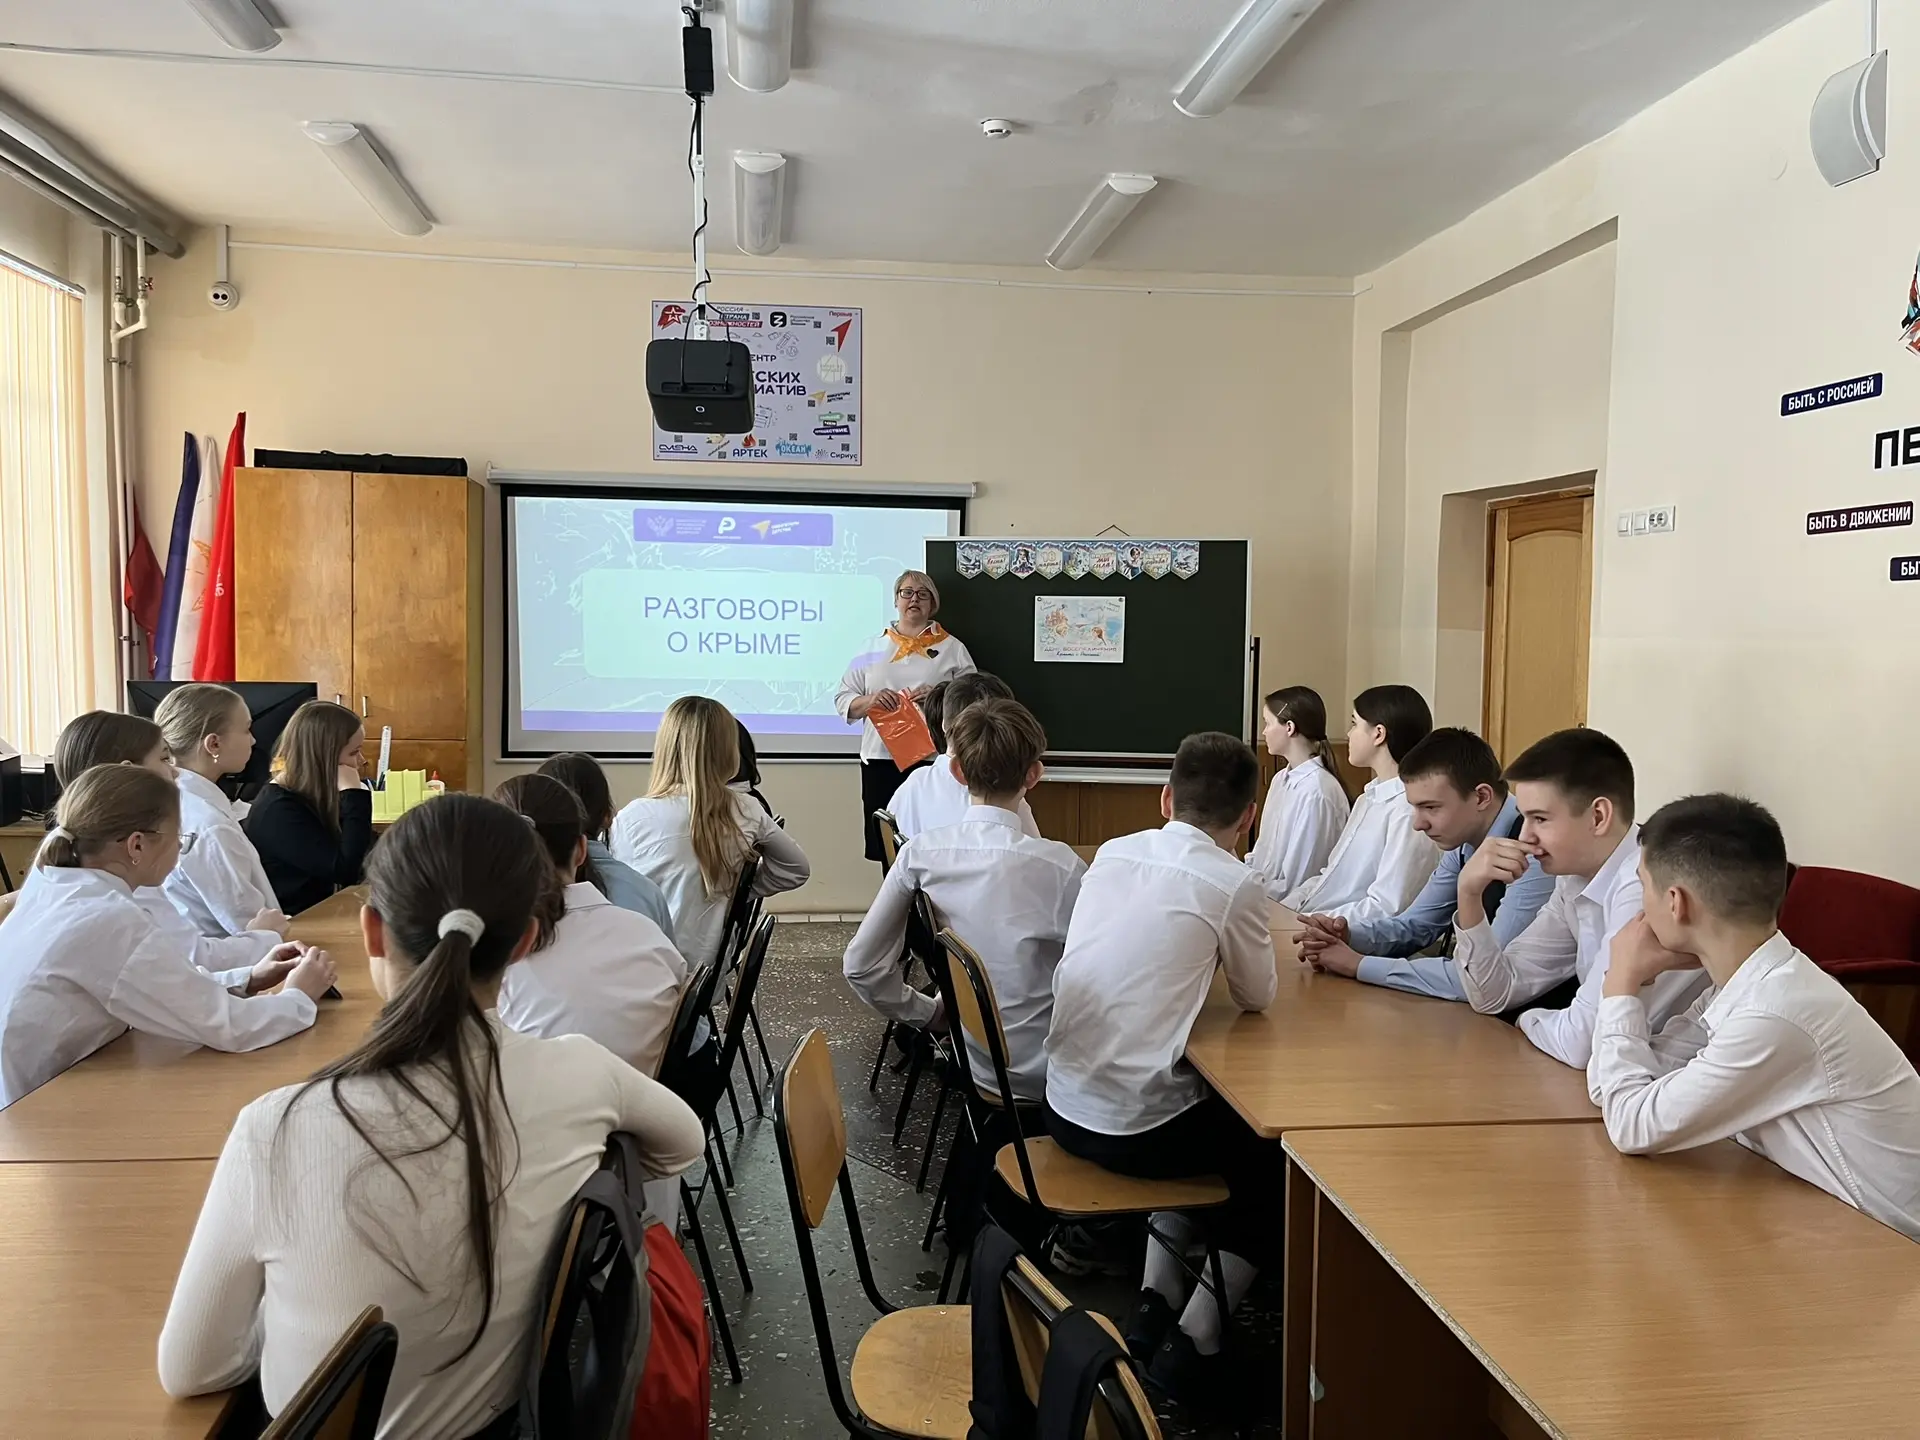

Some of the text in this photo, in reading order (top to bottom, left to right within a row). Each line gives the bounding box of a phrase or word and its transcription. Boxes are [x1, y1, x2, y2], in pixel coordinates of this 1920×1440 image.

[750, 354, 777, 362] ЕНТР
[753, 370, 801, 384] СКИХ
[754, 384, 807, 396] ИАТИВ
[1788, 376, 1874, 411] БЫТЬ С РОССИЕЙ
[732, 448, 768, 458] АРТЕК
[830, 451, 858, 460] Сириус
[1808, 505, 1911, 531] БЫТЬ В ДВИЖЕНИИ
[644, 596, 823, 622] РАЗГОВОРЫ
[667, 631, 801, 655] О КРЫМЕ
